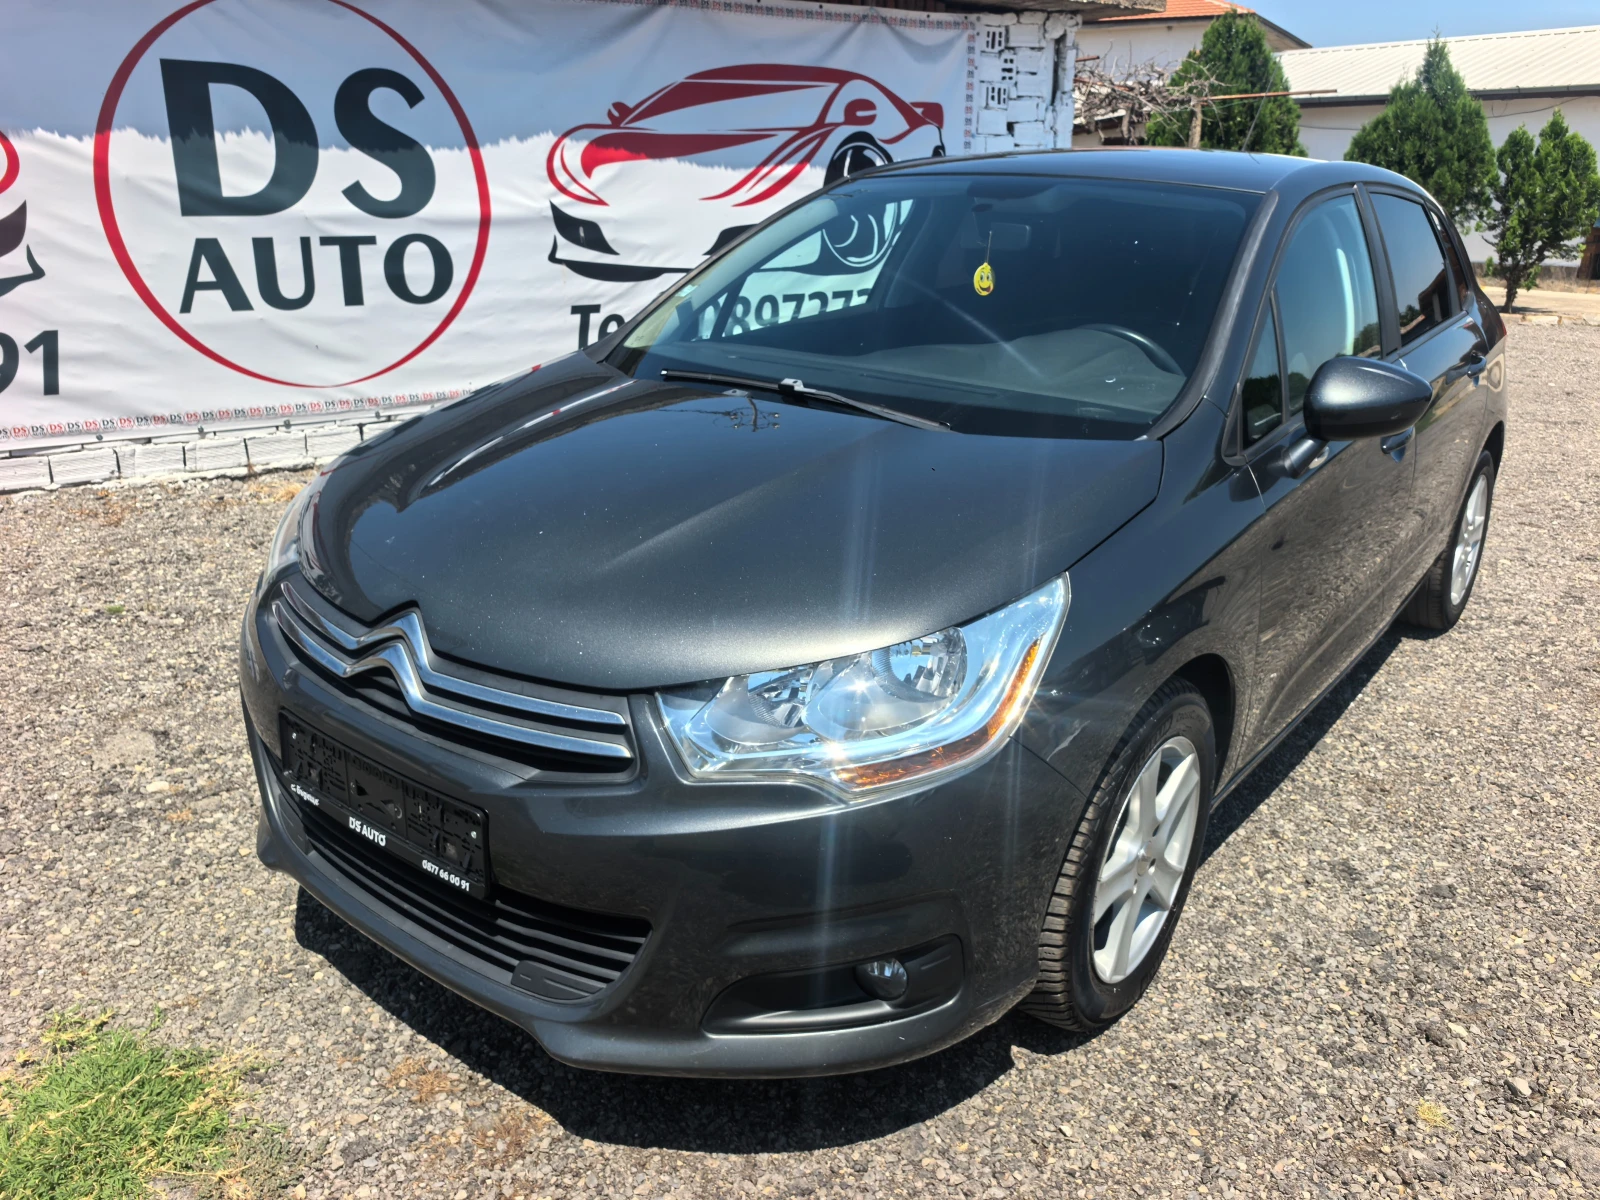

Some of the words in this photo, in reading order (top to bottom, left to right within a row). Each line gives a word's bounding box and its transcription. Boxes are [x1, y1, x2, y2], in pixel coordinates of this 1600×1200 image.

[160, 58, 436, 219] DS
[179, 233, 454, 314] AUTO
[31, 425, 45, 433] DS
[49, 423, 63, 431] DS
[67, 422, 81, 430] DS
[85, 420, 98, 428] DS
[136, 416, 149, 424] DS
[280, 404, 292, 412] DS
[348, 816, 361, 833] DS
[361, 824, 387, 847] AUTO
[421, 859, 439, 875] 0877
[439, 869, 449, 881] 66
[449, 875, 460, 887] 00
[460, 880, 470, 892] 91
